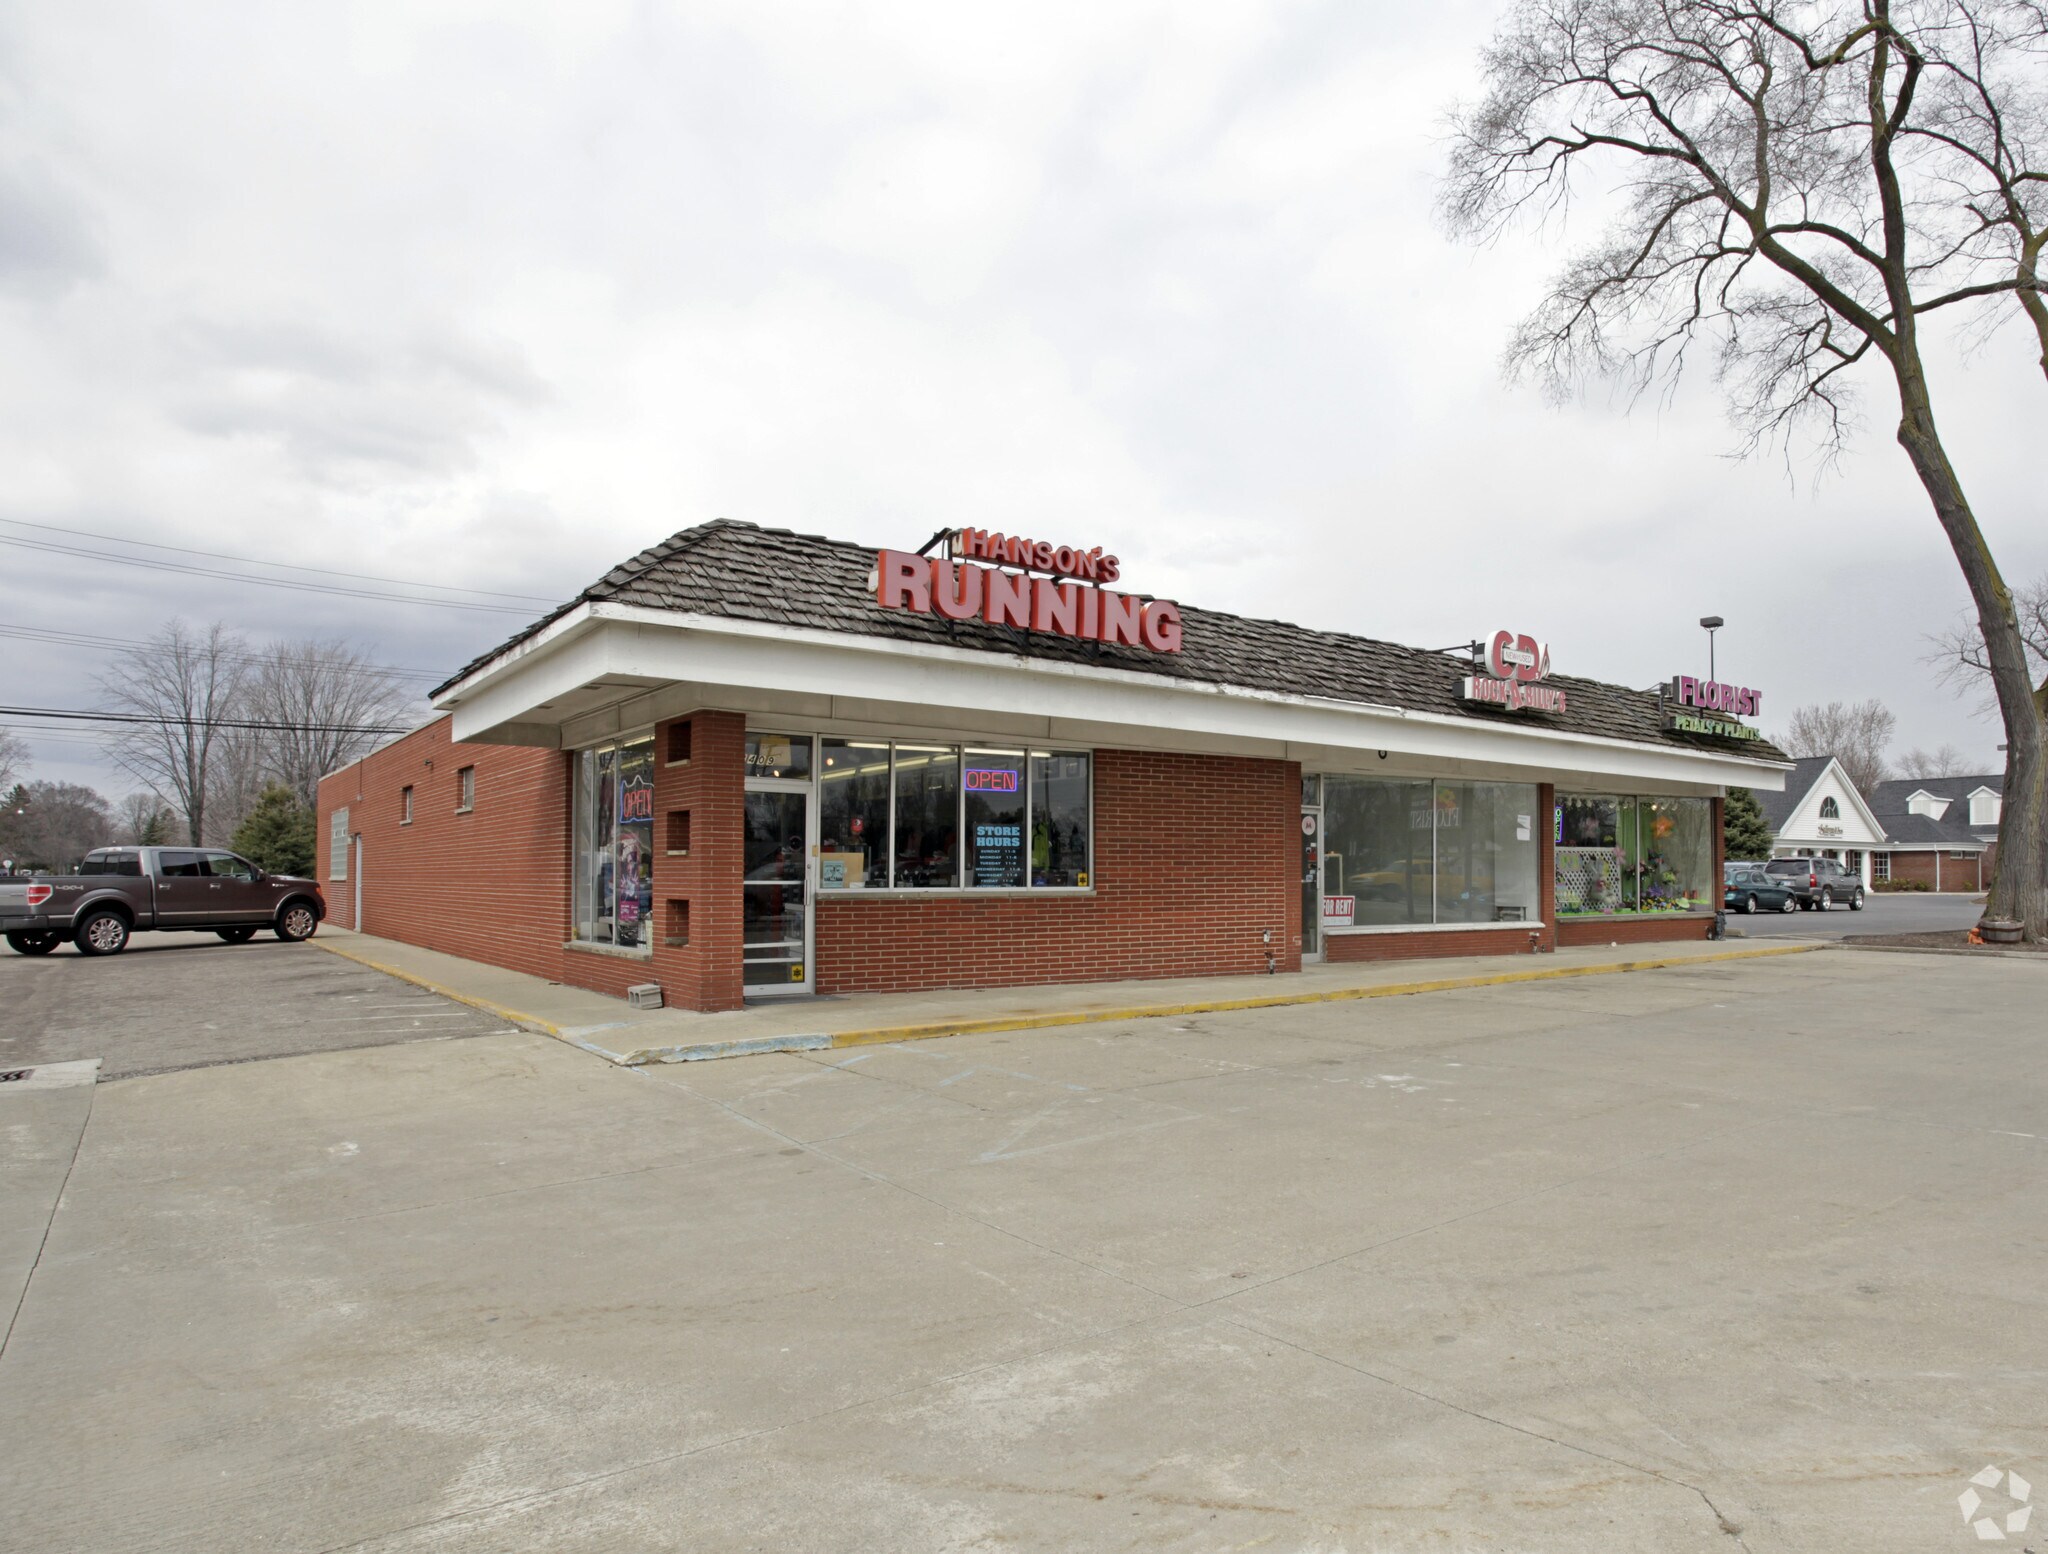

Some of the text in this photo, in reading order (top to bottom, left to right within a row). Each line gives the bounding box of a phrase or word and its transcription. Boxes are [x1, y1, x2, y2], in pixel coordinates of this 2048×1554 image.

[962, 527, 1120, 583] HANSON'S
[878, 550, 1182, 653] RUNNING
[1677, 675, 1763, 717] FLORIST
[1676, 714, 1715, 735] PETALS
[1724, 722, 1761, 741] PLANTS
[745, 754, 774, 766] 409
[966, 771, 1015, 790] OPEN
[624, 789, 652, 817] OPEN
[976, 826, 1020, 836] STORE
[976, 837, 1020, 847] HOURS
[1336, 899, 1353, 916] RENT
